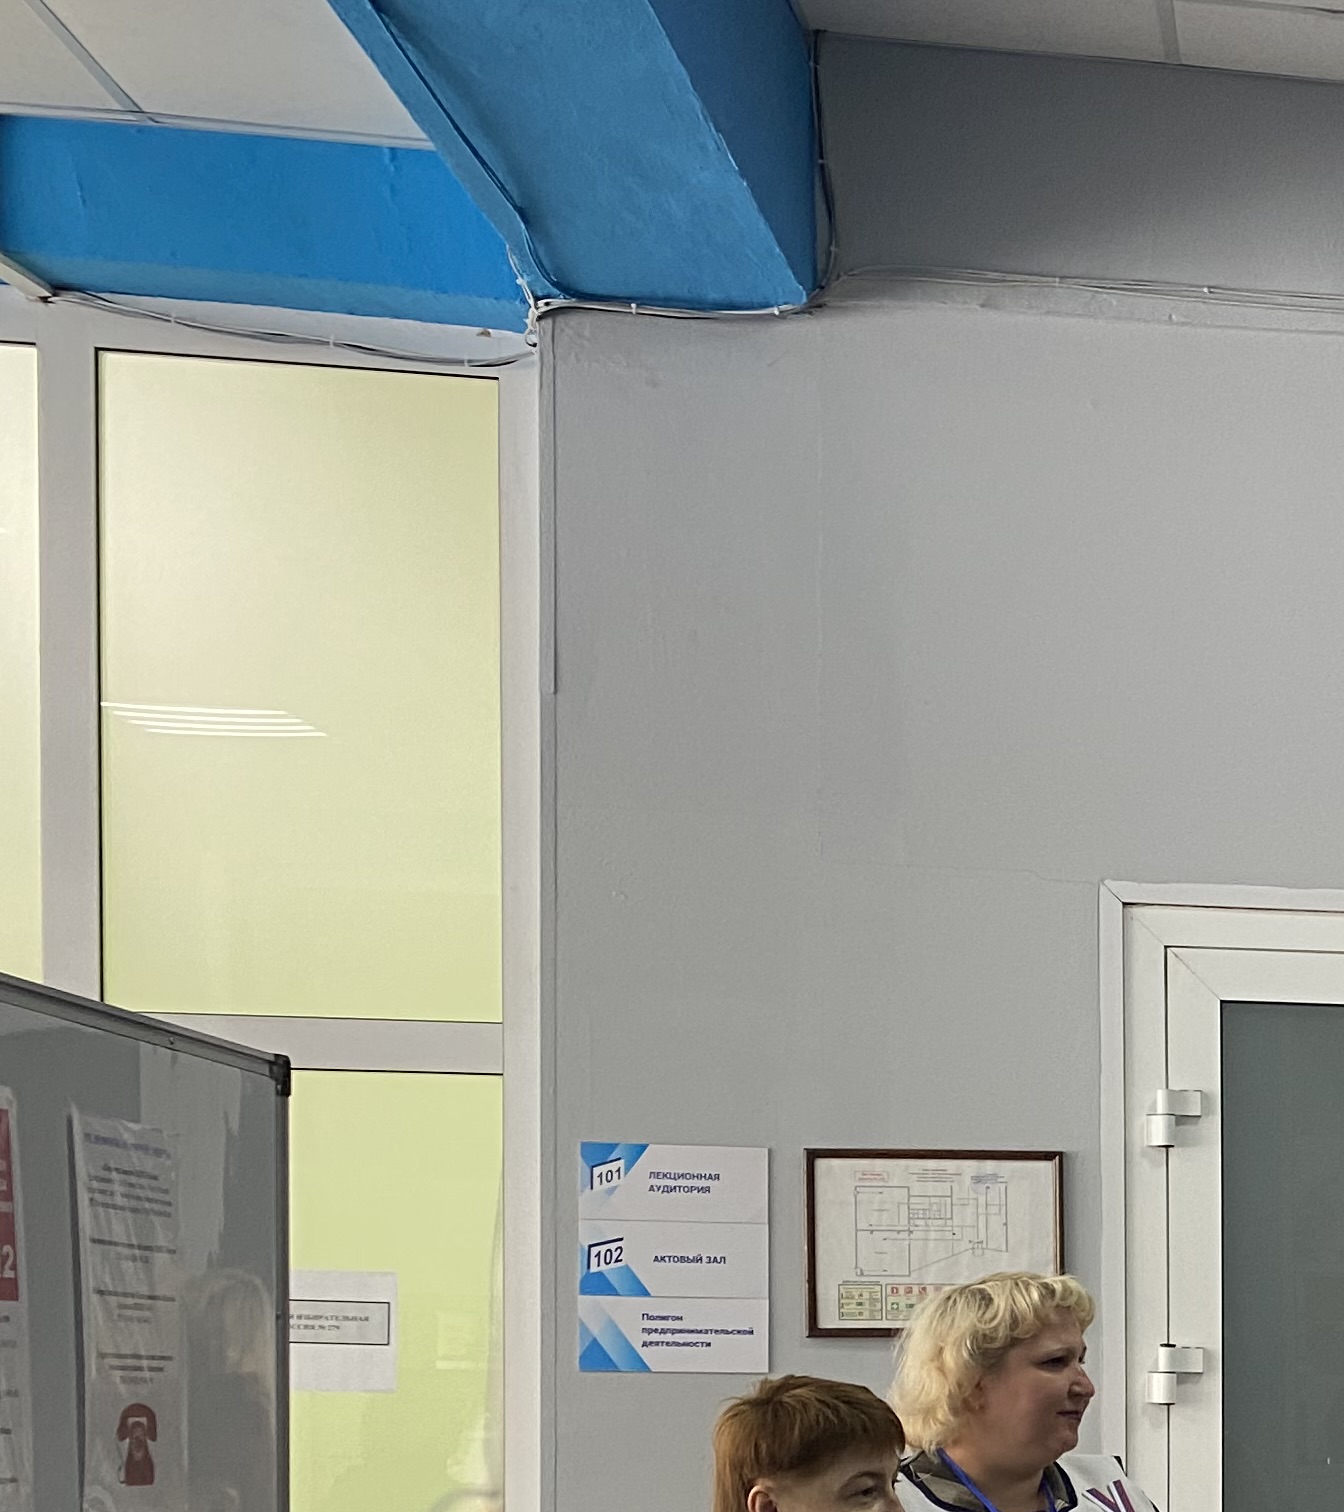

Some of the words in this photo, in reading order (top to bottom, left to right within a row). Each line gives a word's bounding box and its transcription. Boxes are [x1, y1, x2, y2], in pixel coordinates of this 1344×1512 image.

[596, 1166, 622, 1186] 101
[648, 1171, 720, 1182] ЛЕКЦИОННАЯ
[648, 1184, 711, 1194] АУДИТОРИЯ
[594, 1245, 624, 1268] 102
[652, 1254, 703, 1265] АКТОВЫЙ
[706, 1256, 726, 1265] ЗАЛ
[641, 1312, 684, 1322] Полигон
[641, 1326, 755, 1336] предпринимательской
[641, 1340, 712, 1349] деятельности
